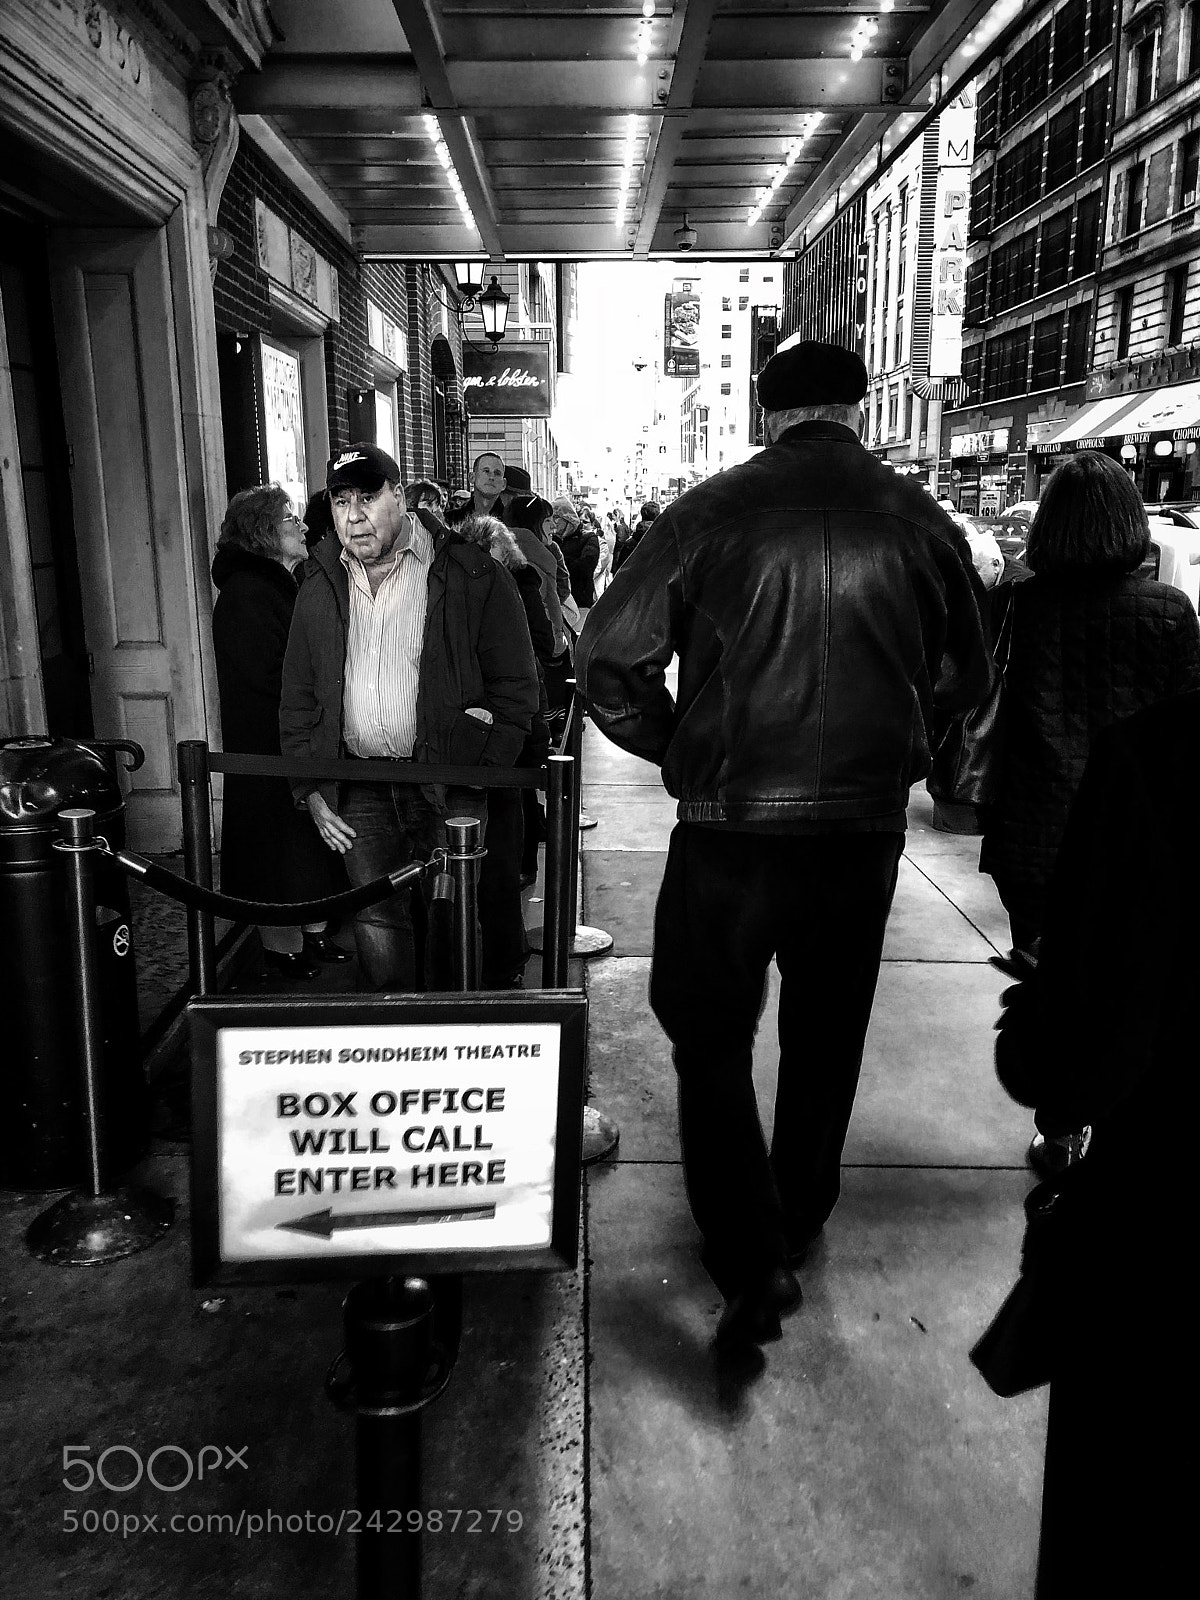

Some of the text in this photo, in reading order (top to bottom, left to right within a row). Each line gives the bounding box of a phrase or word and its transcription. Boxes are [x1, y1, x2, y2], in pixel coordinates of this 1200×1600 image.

[937, 190, 967, 315] PARK
[485, 376, 497, 386] &
[497, 368, 539, 387] lobster
[1036, 443, 1062, 453] HEARTLAND
[1076, 438, 1106, 449] CHOPHOUSE
[1123, 432, 1152, 445] BREWERY
[338, 451, 360, 463] NIKE
[238, 1043, 541, 1066] STEPHEN SONDHEIM THEATRE
[276, 1087, 506, 1118] BOX OFFICE
[290, 1124, 493, 1156] WILL CALL
[274, 1158, 506, 1197] ENTER HERE
